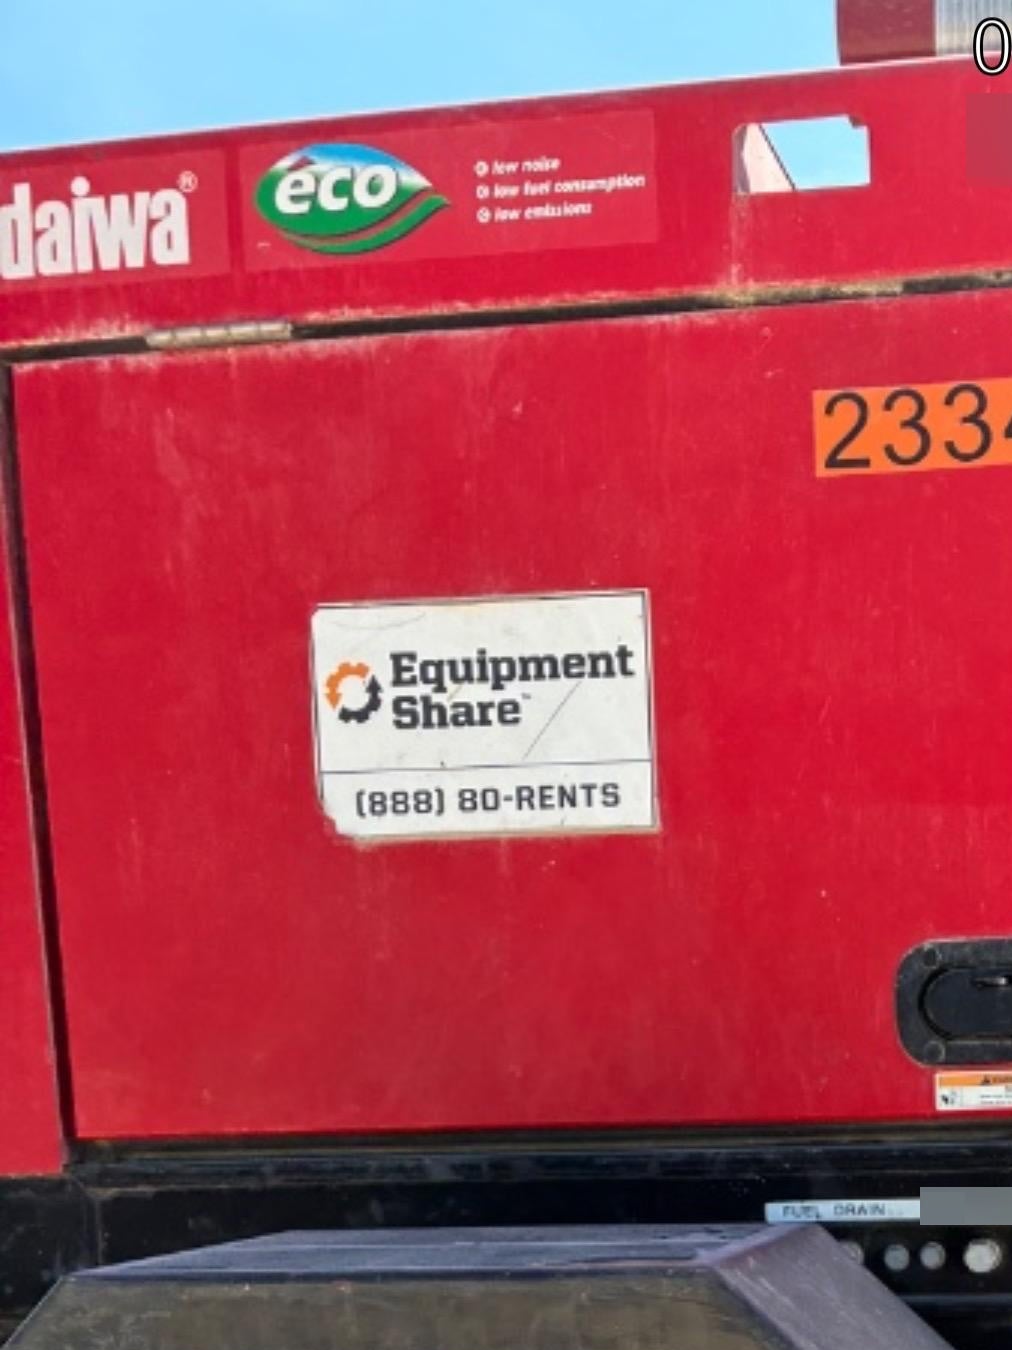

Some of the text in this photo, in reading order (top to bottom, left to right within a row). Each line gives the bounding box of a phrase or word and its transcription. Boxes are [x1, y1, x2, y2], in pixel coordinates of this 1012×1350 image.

[275, 164, 398, 214] eco
[390, 645, 635, 693] Equipment
[355, 783, 620, 817] (888) 80-RENTS
[833, 1203, 886, 1217] DRAIN
